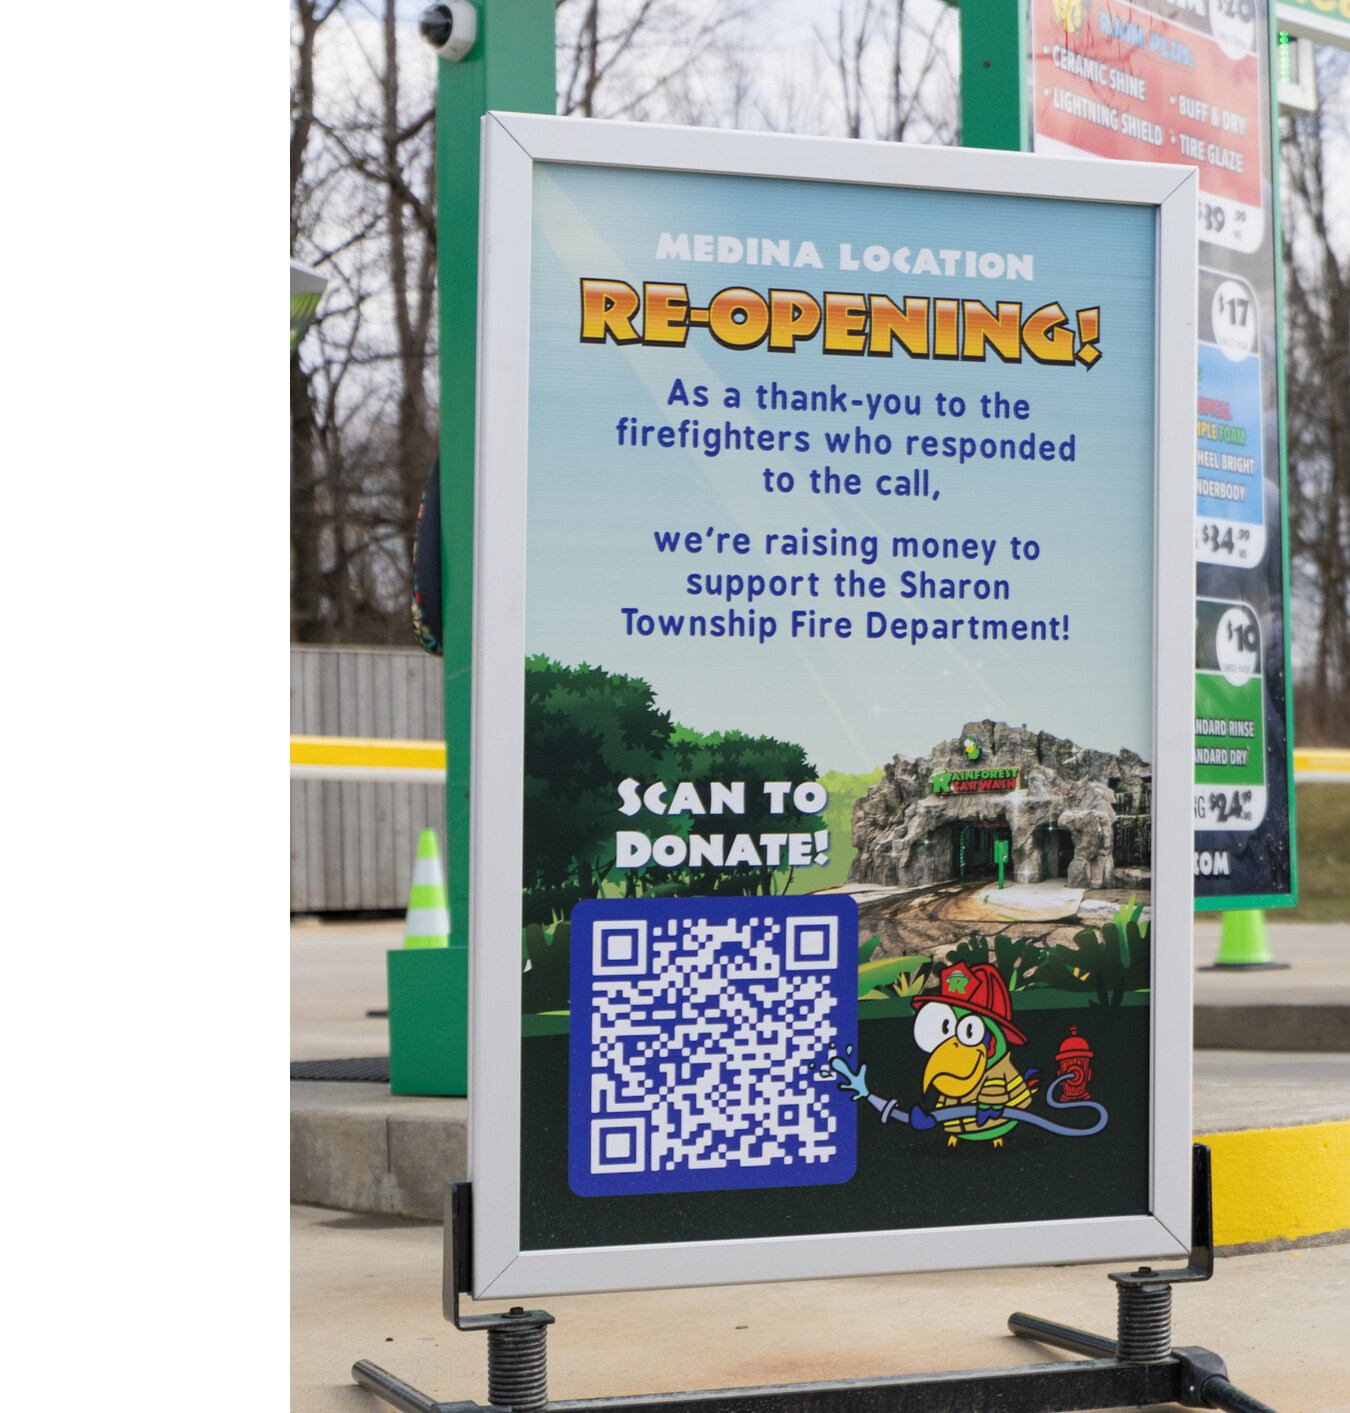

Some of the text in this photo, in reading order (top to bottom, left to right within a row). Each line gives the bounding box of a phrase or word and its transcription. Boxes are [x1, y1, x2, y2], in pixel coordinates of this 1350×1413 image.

[1052, 44, 1146, 102] CERAMIC SHINE
[1053, 86, 1164, 147] LIGHTNING SHIELD
[1178, 93, 1208, 124] BUFF
[1222, 111, 1247, 136] DRY
[1178, 133, 1243, 174] TIRE GLAZE
[655, 231, 1035, 282] MEDINA LOCATION
[580, 277, 1103, 372] RE-OPENING!
[1218, 292, 1250, 328] $17
[667, 378, 1031, 421] As a thank-you to the
[616, 417, 1077, 464] firefighters who responded
[1218, 424, 1246, 446] FOAM
[762, 465, 941, 502] to the call,
[1221, 453, 1255, 476] BRIGHT
[765, 527, 879, 565] raising
[891, 535, 997, 567] money
[1010, 535, 1041, 561] to
[1202, 524, 1235, 555] $34
[686, 569, 1011, 602] support the Sharon
[620, 607, 1071, 646] Township Fire Department!
[1228, 620, 1260, 653] $10
[1228, 719, 1255, 738] RINSE
[1229, 748, 1248, 766] DRY
[617, 777, 828, 817] SCAN TO
[932, 768, 1019, 793] RAINFOREST
[952, 779, 1017, 792] CAR WASH
[615, 829, 830, 869] DONATE!
